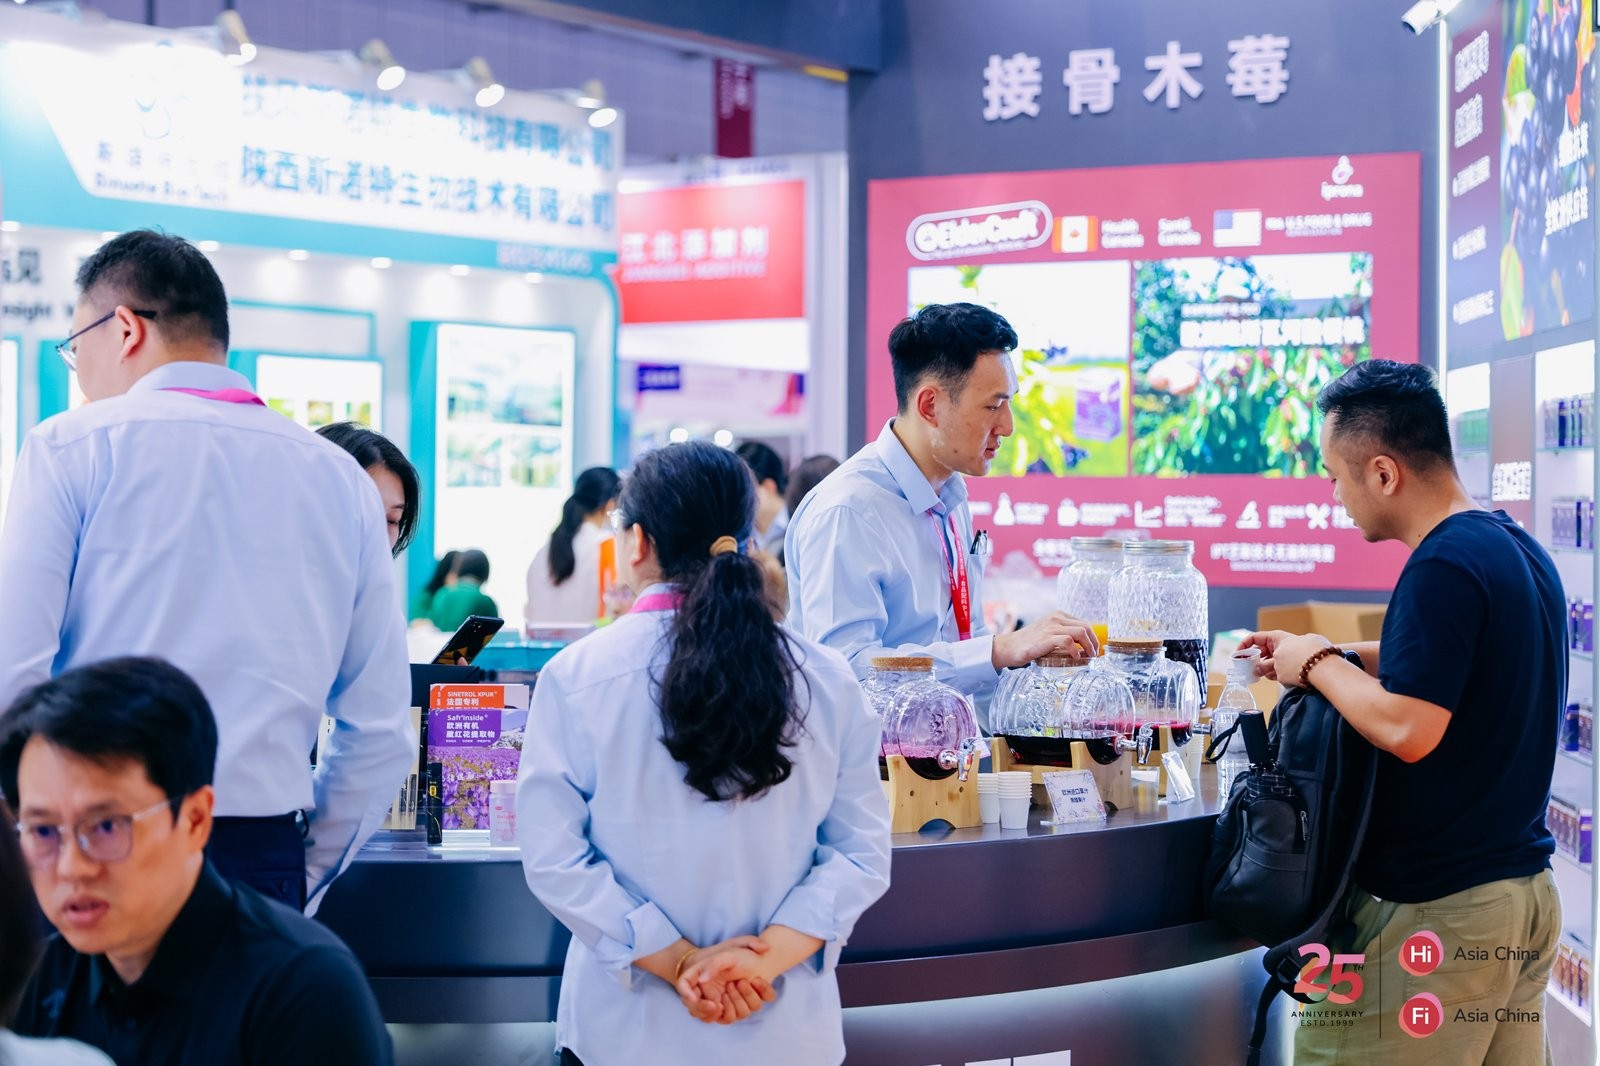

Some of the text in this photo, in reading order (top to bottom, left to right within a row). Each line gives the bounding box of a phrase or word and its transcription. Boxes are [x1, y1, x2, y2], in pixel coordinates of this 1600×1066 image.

[983, 34, 1291, 121] 接骨木莓
[446, 698, 479, 706] 法国专利
[446, 722, 479, 730] 欧洲有机
